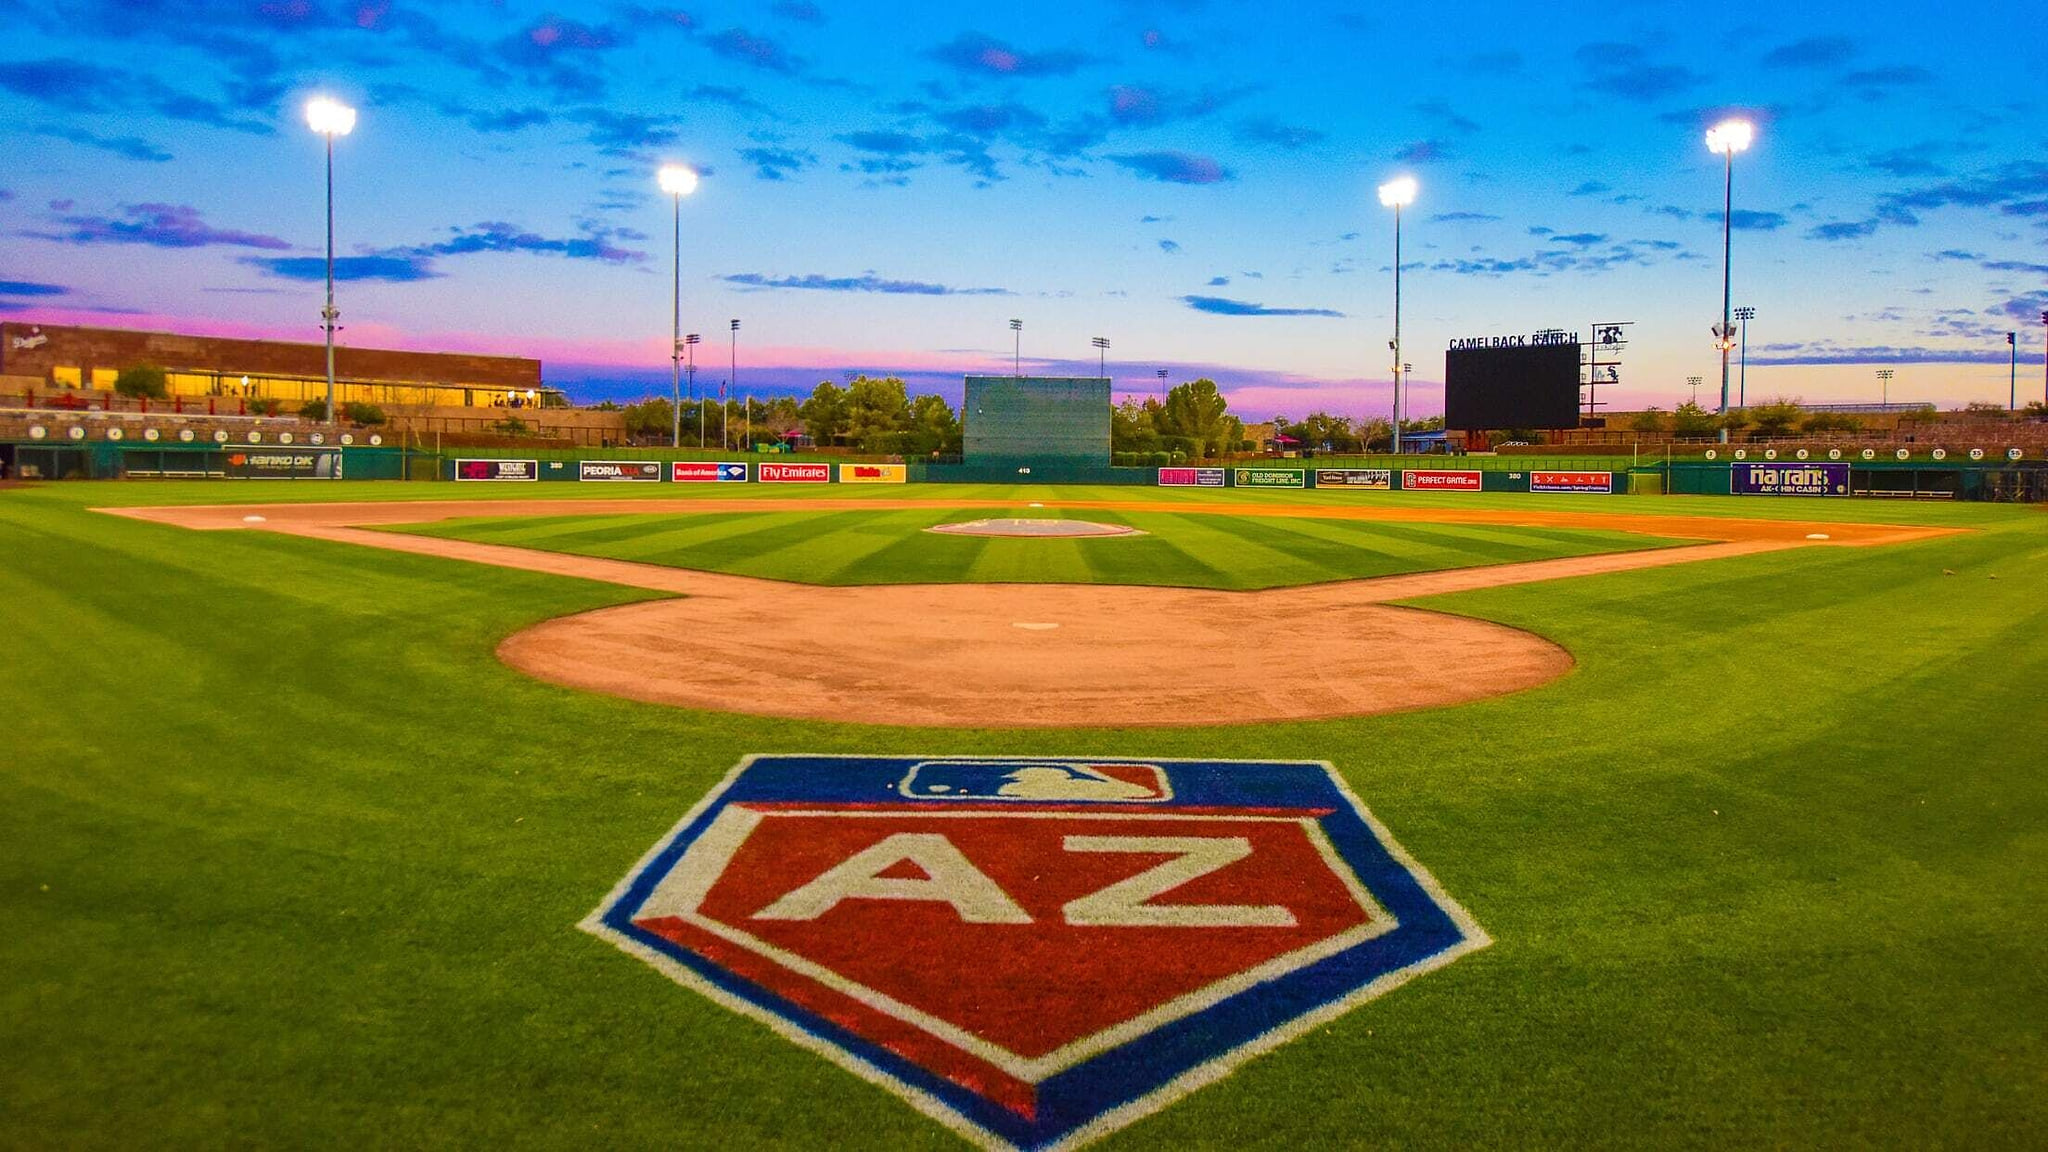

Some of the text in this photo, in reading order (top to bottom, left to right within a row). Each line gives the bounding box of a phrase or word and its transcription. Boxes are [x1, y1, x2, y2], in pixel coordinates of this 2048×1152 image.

[1449, 332, 1577, 350] CAMELBACK RANCH
[583, 466, 622, 475] PEORIA
[763, 467, 826, 479] Fly Emirates
[750, 831, 1297, 928] AZ
